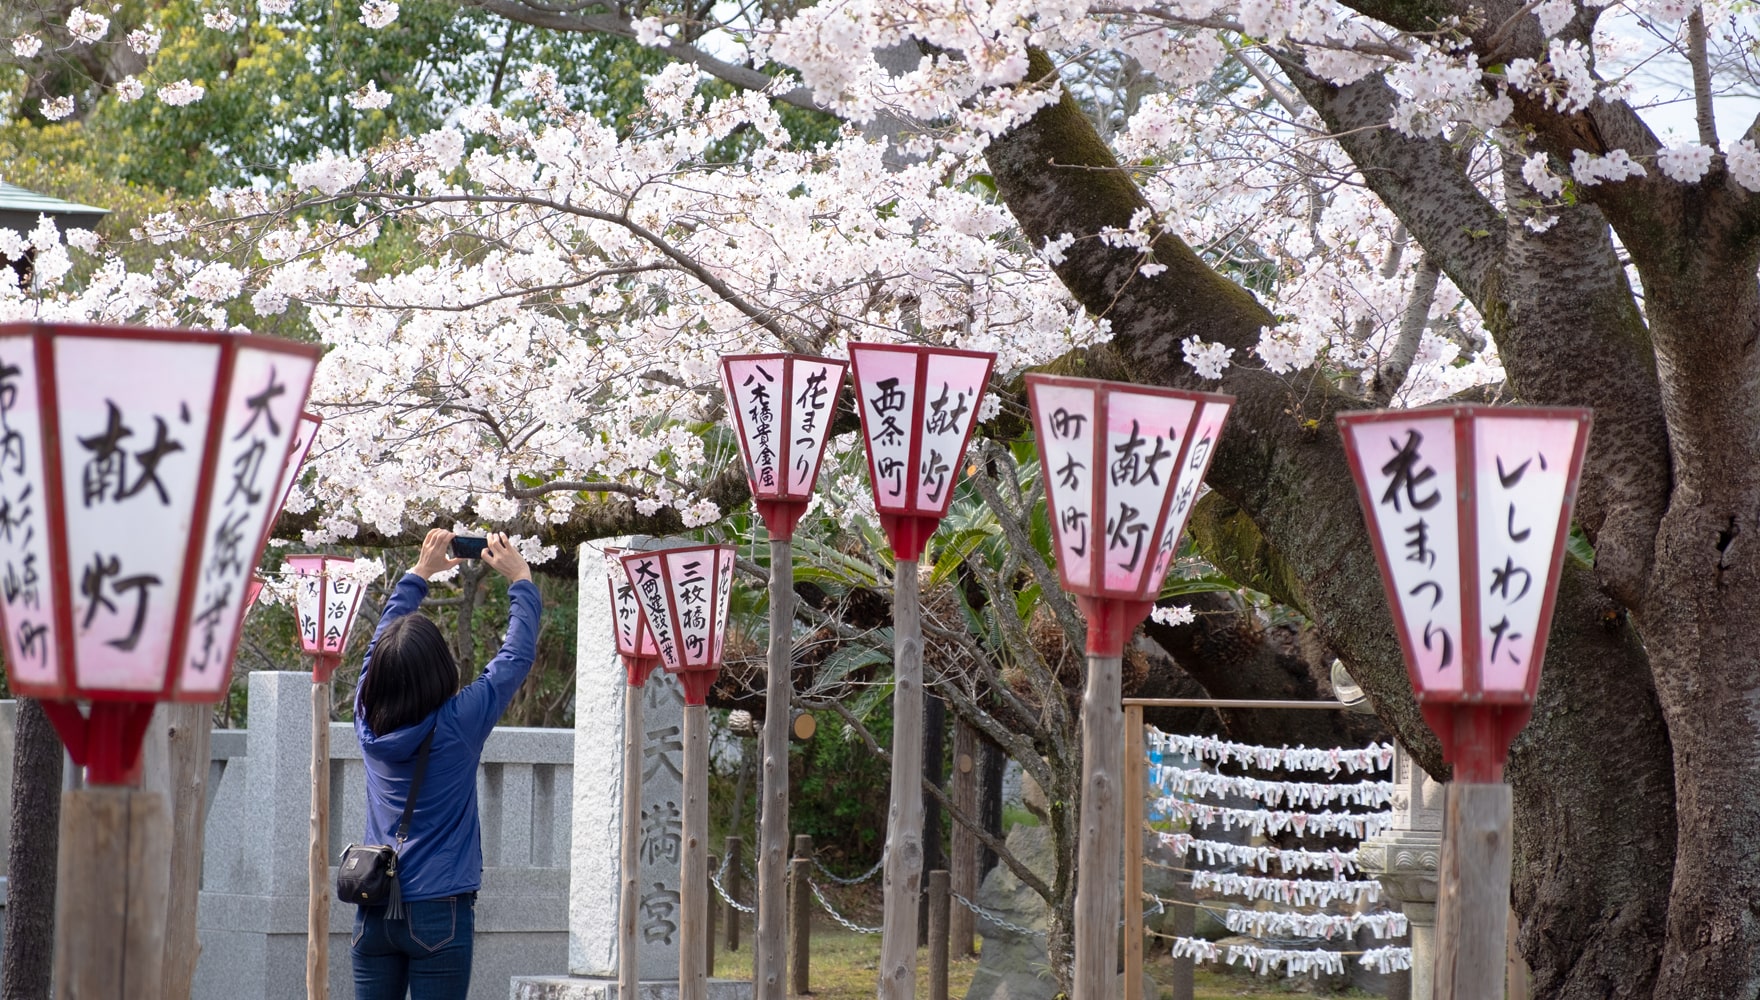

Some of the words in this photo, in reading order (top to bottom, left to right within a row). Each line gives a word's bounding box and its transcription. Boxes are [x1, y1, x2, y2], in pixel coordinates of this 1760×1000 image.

[796, 367, 828, 486] 花まつり
[870, 377, 906, 497] 西条町
[921, 381, 973, 503] 献灯
[1049, 407, 1088, 558] 町方町
[77, 397, 192, 653] 献灯
[1106, 418, 1176, 573] 献灯
[1154, 427, 1211, 574] 自治会
[1381, 428, 1454, 672] 花まつり
[325, 578, 351, 648] 自治会
[635, 559, 677, 664] 大岡建設工業
[679, 561, 707, 658] 三枚橋町
[714, 557, 730, 657] 花まつり
[1489, 451, 1548, 665] いしわた
